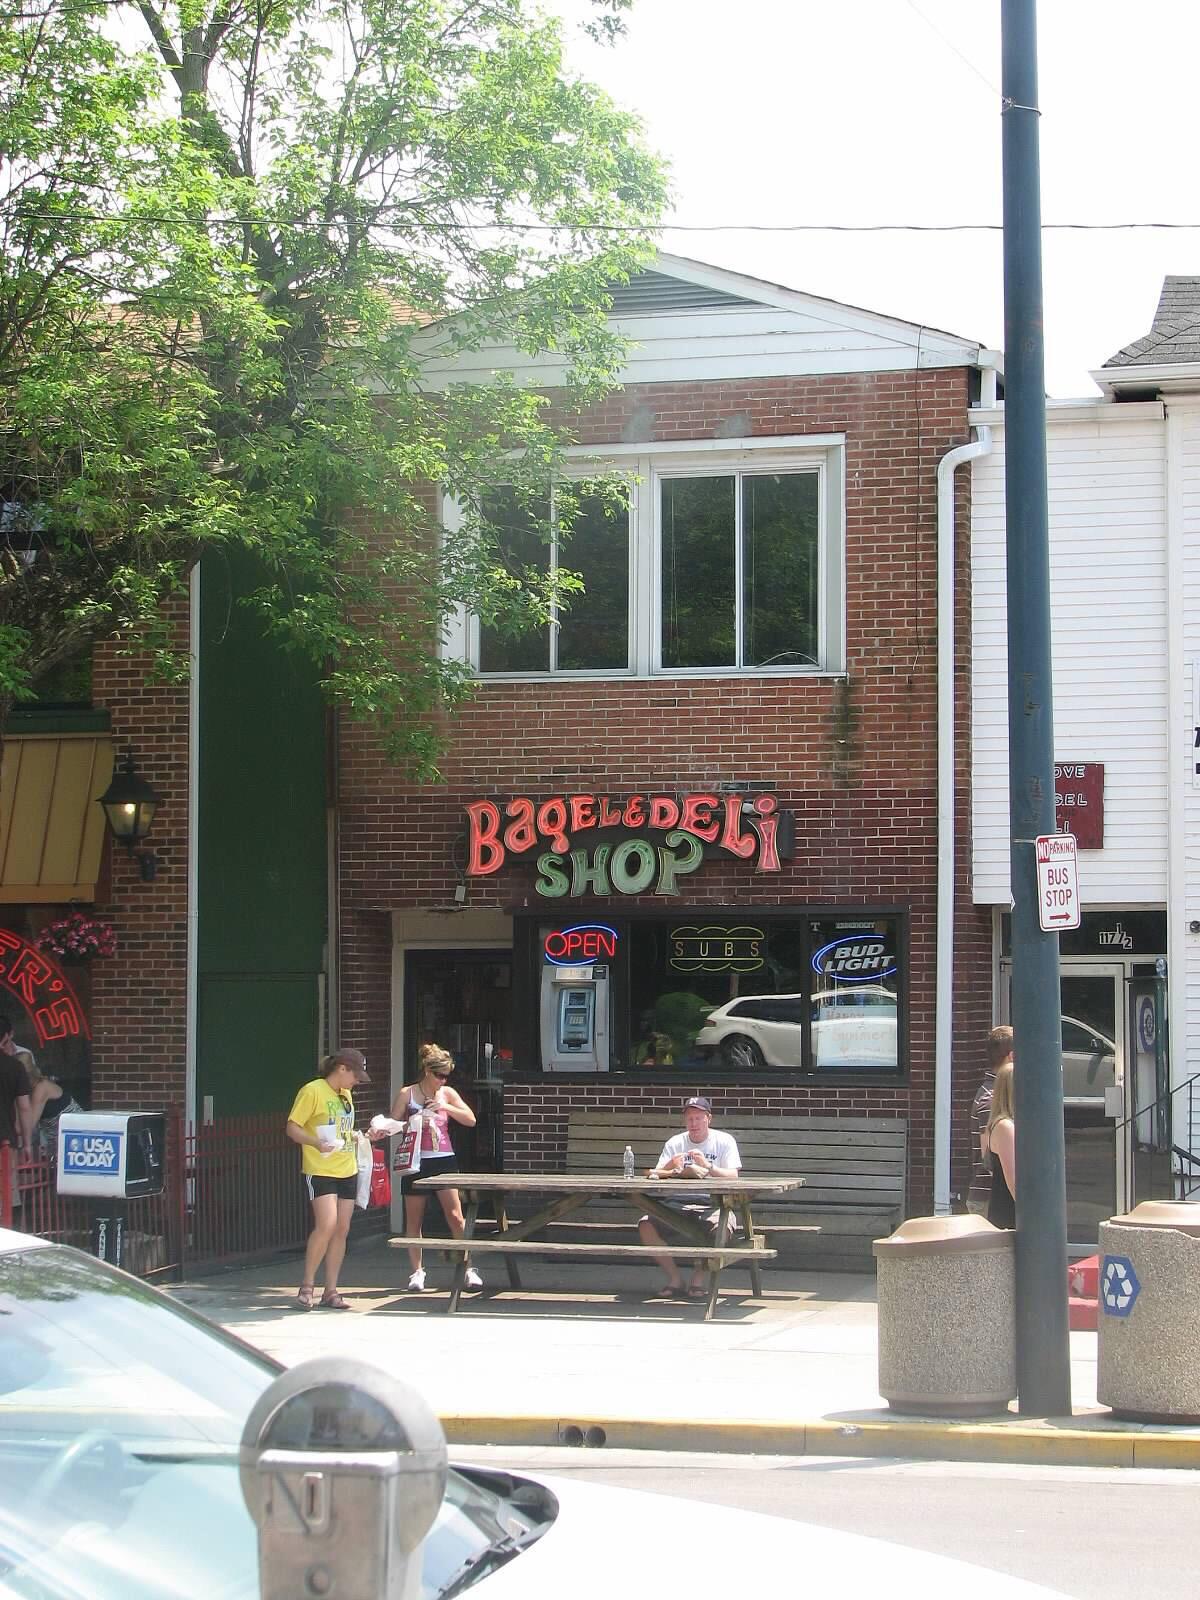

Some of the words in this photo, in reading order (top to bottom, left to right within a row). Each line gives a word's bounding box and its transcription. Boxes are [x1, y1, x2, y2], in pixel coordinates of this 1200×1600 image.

[622, 795, 644, 827] &
[1038, 841, 1049, 860] NO
[1049, 841, 1074, 855] PARKING
[535, 831, 703, 897] SHOP
[1047, 868, 1069, 886] BUS
[1046, 889, 1072, 908] STOP
[545, 932, 616, 957] OPEN
[674, 941, 759, 958] SUBS
[834, 944, 884, 959] BUD
[825, 955, 894, 972] LIGHT
[83, 1138, 114, 1153] USA
[67, 1152, 116, 1167] TODAY
